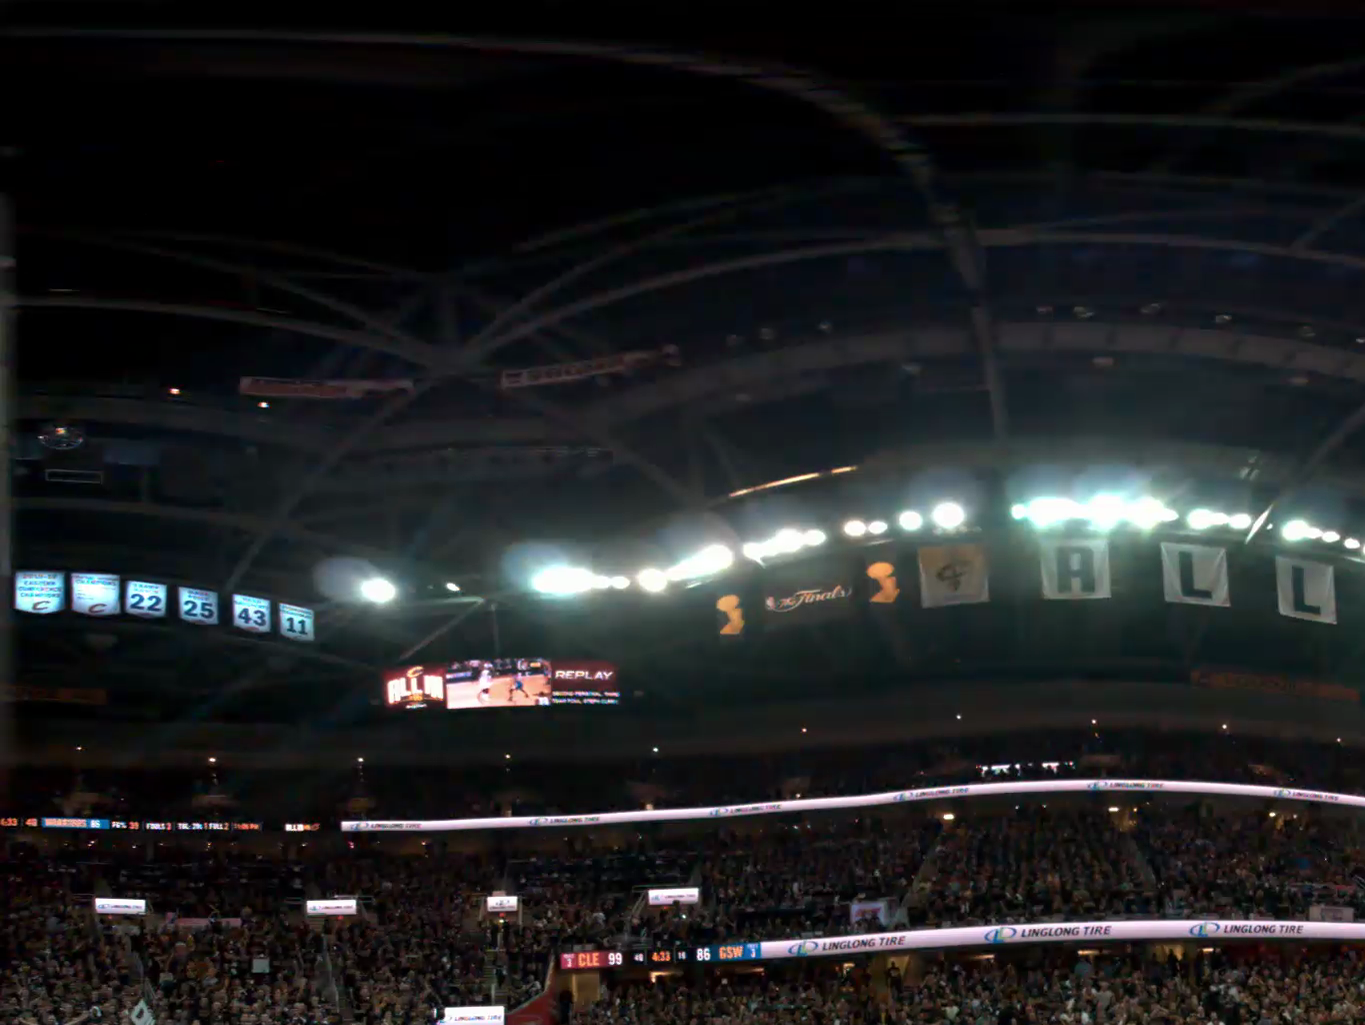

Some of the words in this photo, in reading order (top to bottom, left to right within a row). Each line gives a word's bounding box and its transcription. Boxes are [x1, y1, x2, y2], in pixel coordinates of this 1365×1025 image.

[130, 594, 162, 612] 22
[184, 600, 215, 619] 25
[237, 608, 267, 627] 43
[286, 617, 308, 635] 11
[555, 671, 613, 680] REPLAY
[1021, 926, 1080, 938] LINGLONG
[1083, 925, 1111, 936] TIRE
[1224, 923, 1276, 934] LINGLONG
[1280, 924, 1304, 935] TIRE
[822, 938, 877, 952] LINGLONG
[880, 936, 905, 948] TIRE
[578, 952, 600, 967] CLE
[608, 952, 622, 966] 99
[652, 950, 671, 962] 4:33
[696, 948, 711, 961] 86
[719, 945, 743, 959] GSW
